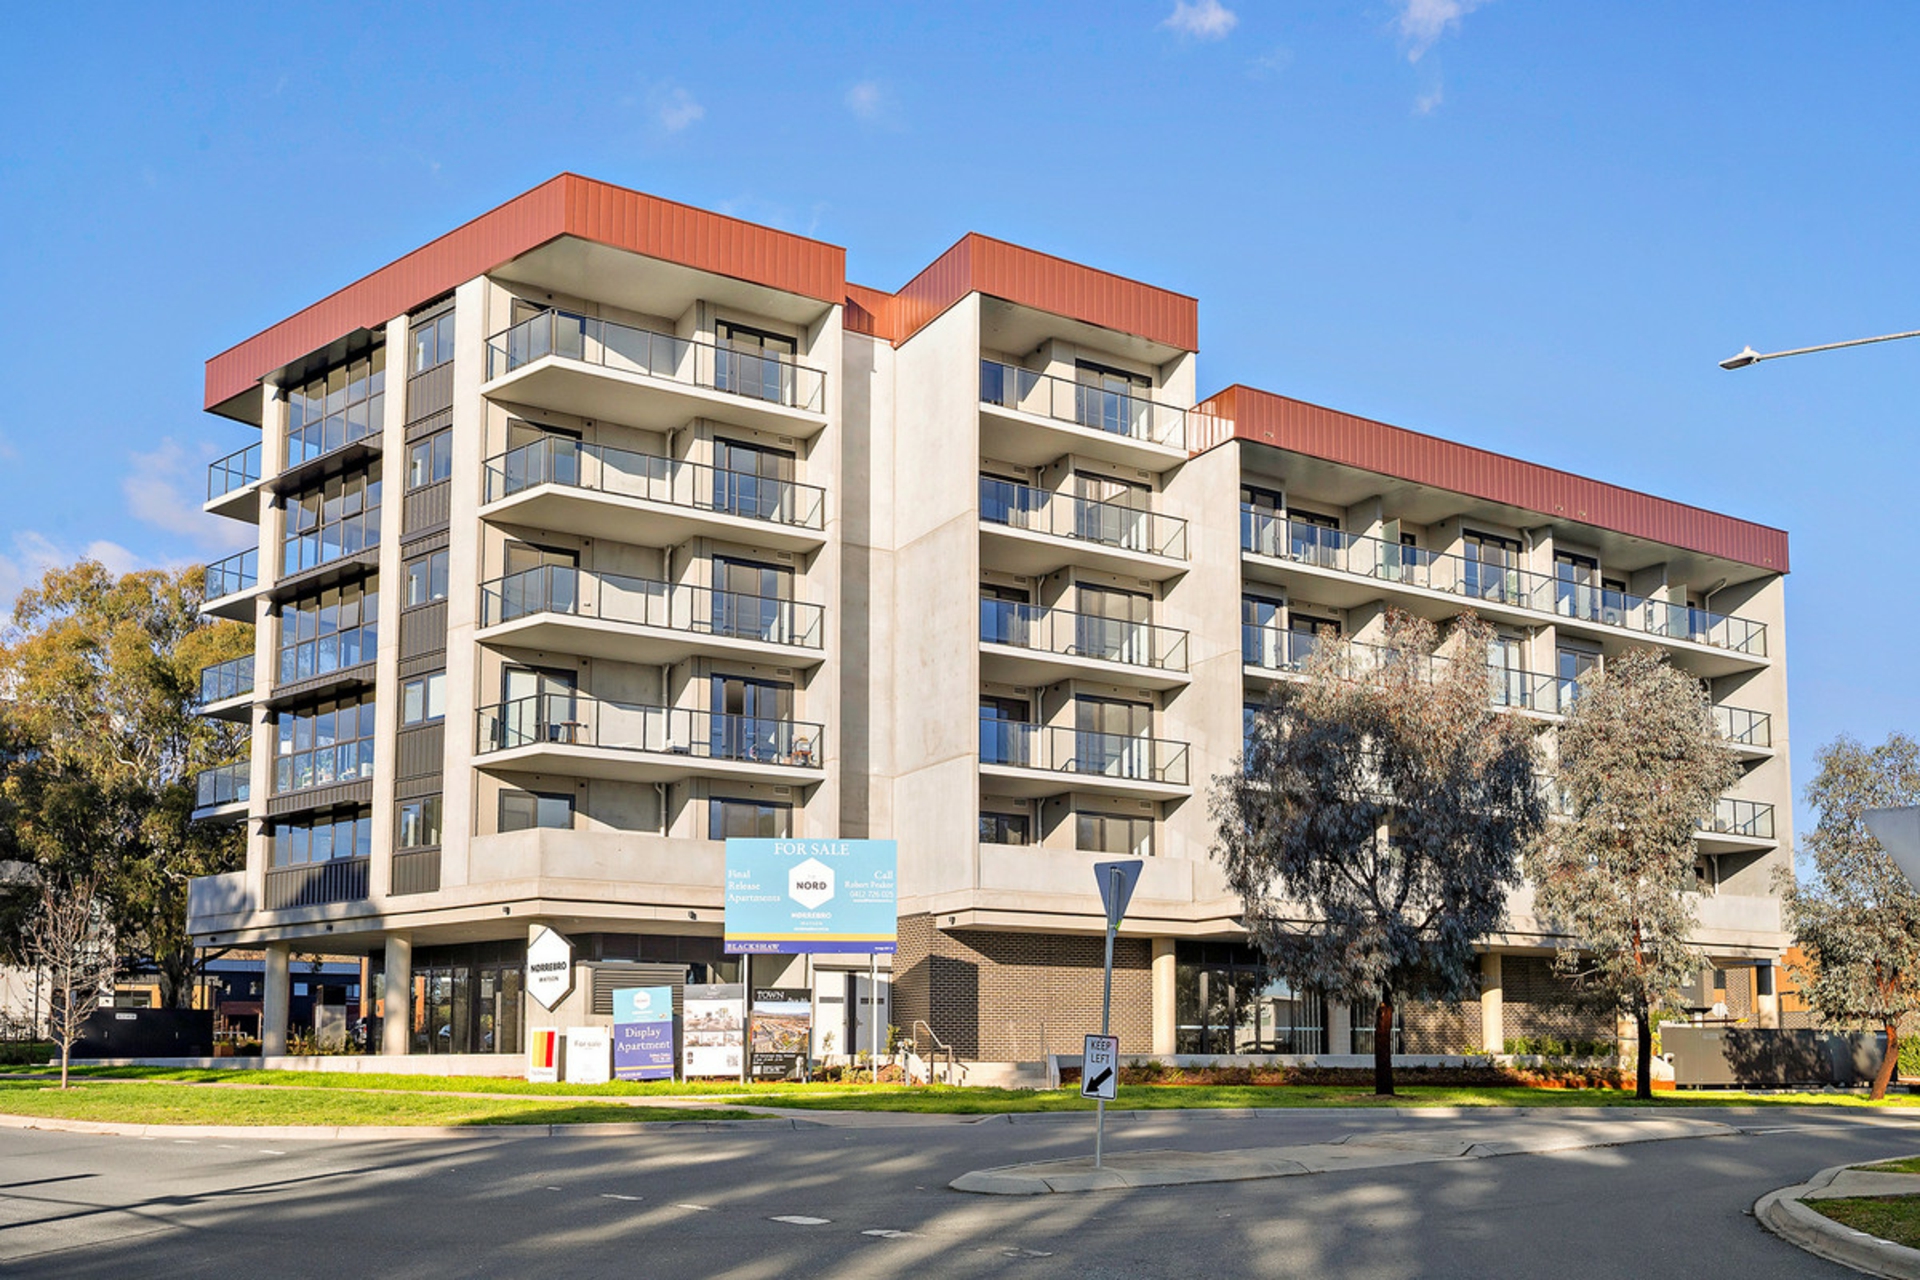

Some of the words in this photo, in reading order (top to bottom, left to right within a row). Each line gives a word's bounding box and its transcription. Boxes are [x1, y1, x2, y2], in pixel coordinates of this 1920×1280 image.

[774, 842, 807, 855] FOR
[811, 842, 850, 856] SALE
[728, 870, 751, 879] Final
[874, 870, 893, 880] Call
[728, 881, 760, 891] Release
[796, 881, 827, 891] NORD
[728, 894, 780, 904] Apartments
[727, 943, 780, 952] BLACKSHAW
[756, 990, 784, 1000] TOWN
[625, 1026, 661, 1039] Display
[617, 1041, 670, 1053] Apartment
[1091, 1040, 1112, 1051] KEEP
[1091, 1054, 1109, 1064] LEFT
